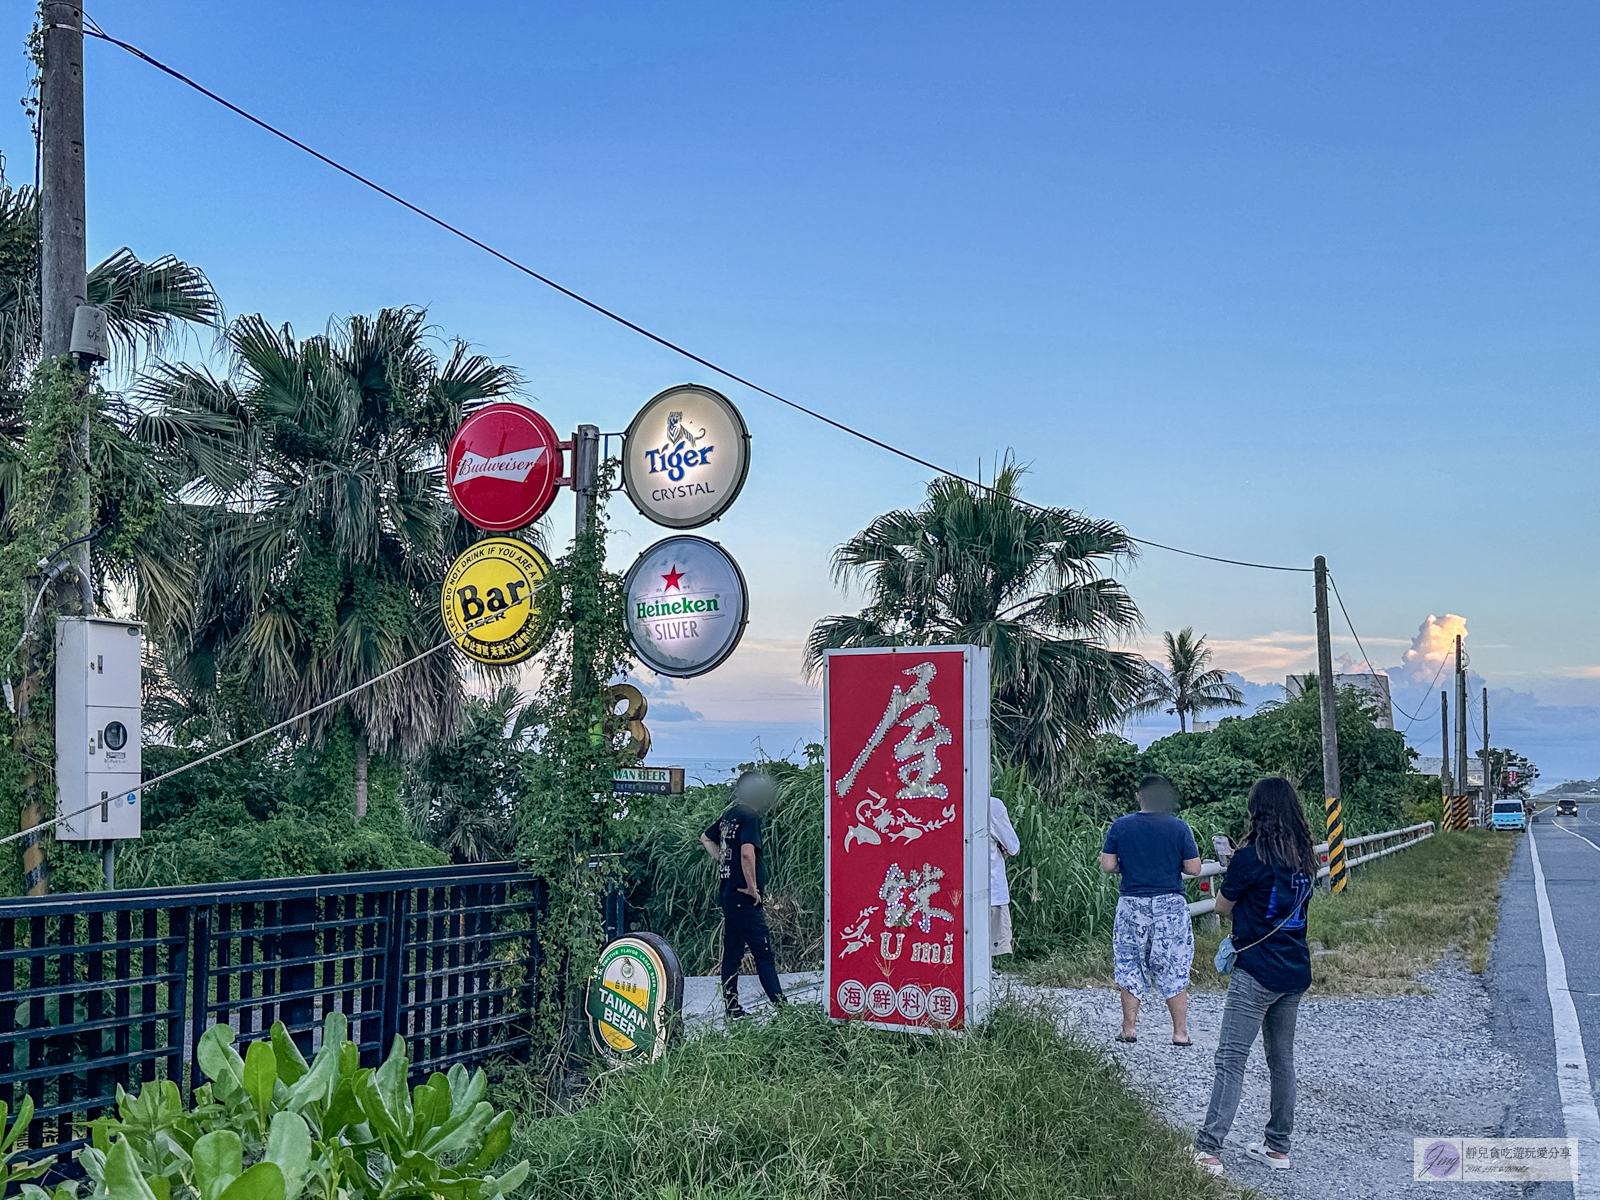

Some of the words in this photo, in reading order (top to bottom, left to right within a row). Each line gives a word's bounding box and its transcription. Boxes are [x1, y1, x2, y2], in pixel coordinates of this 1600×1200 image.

[456, 457, 535, 476] Budweiser
[645, 441, 715, 481] Tiger
[652, 482, 715, 502] CRYSTAL
[445, 588, 453, 601] DO
[450, 567, 461, 586] NOT
[461, 548, 485, 568] DRINK
[487, 546, 497, 555] IF
[498, 547, 517, 559] YOU
[515, 555, 533, 571] ARE
[529, 571, 538, 579] A
[456, 580, 525, 623] Bar
[636, 597, 719, 619] Heineken
[465, 611, 507, 630] BEER
[655, 620, 700, 641] SILVER
[613, 769, 636, 780] WAN
[638, 770, 667, 781] BEER
[880, 931, 954, 965] Umi
[599, 987, 648, 1031] TAIWAN
[842, 985, 953, 1017] 海鮮料理
[603, 1008, 636, 1039] BEER
